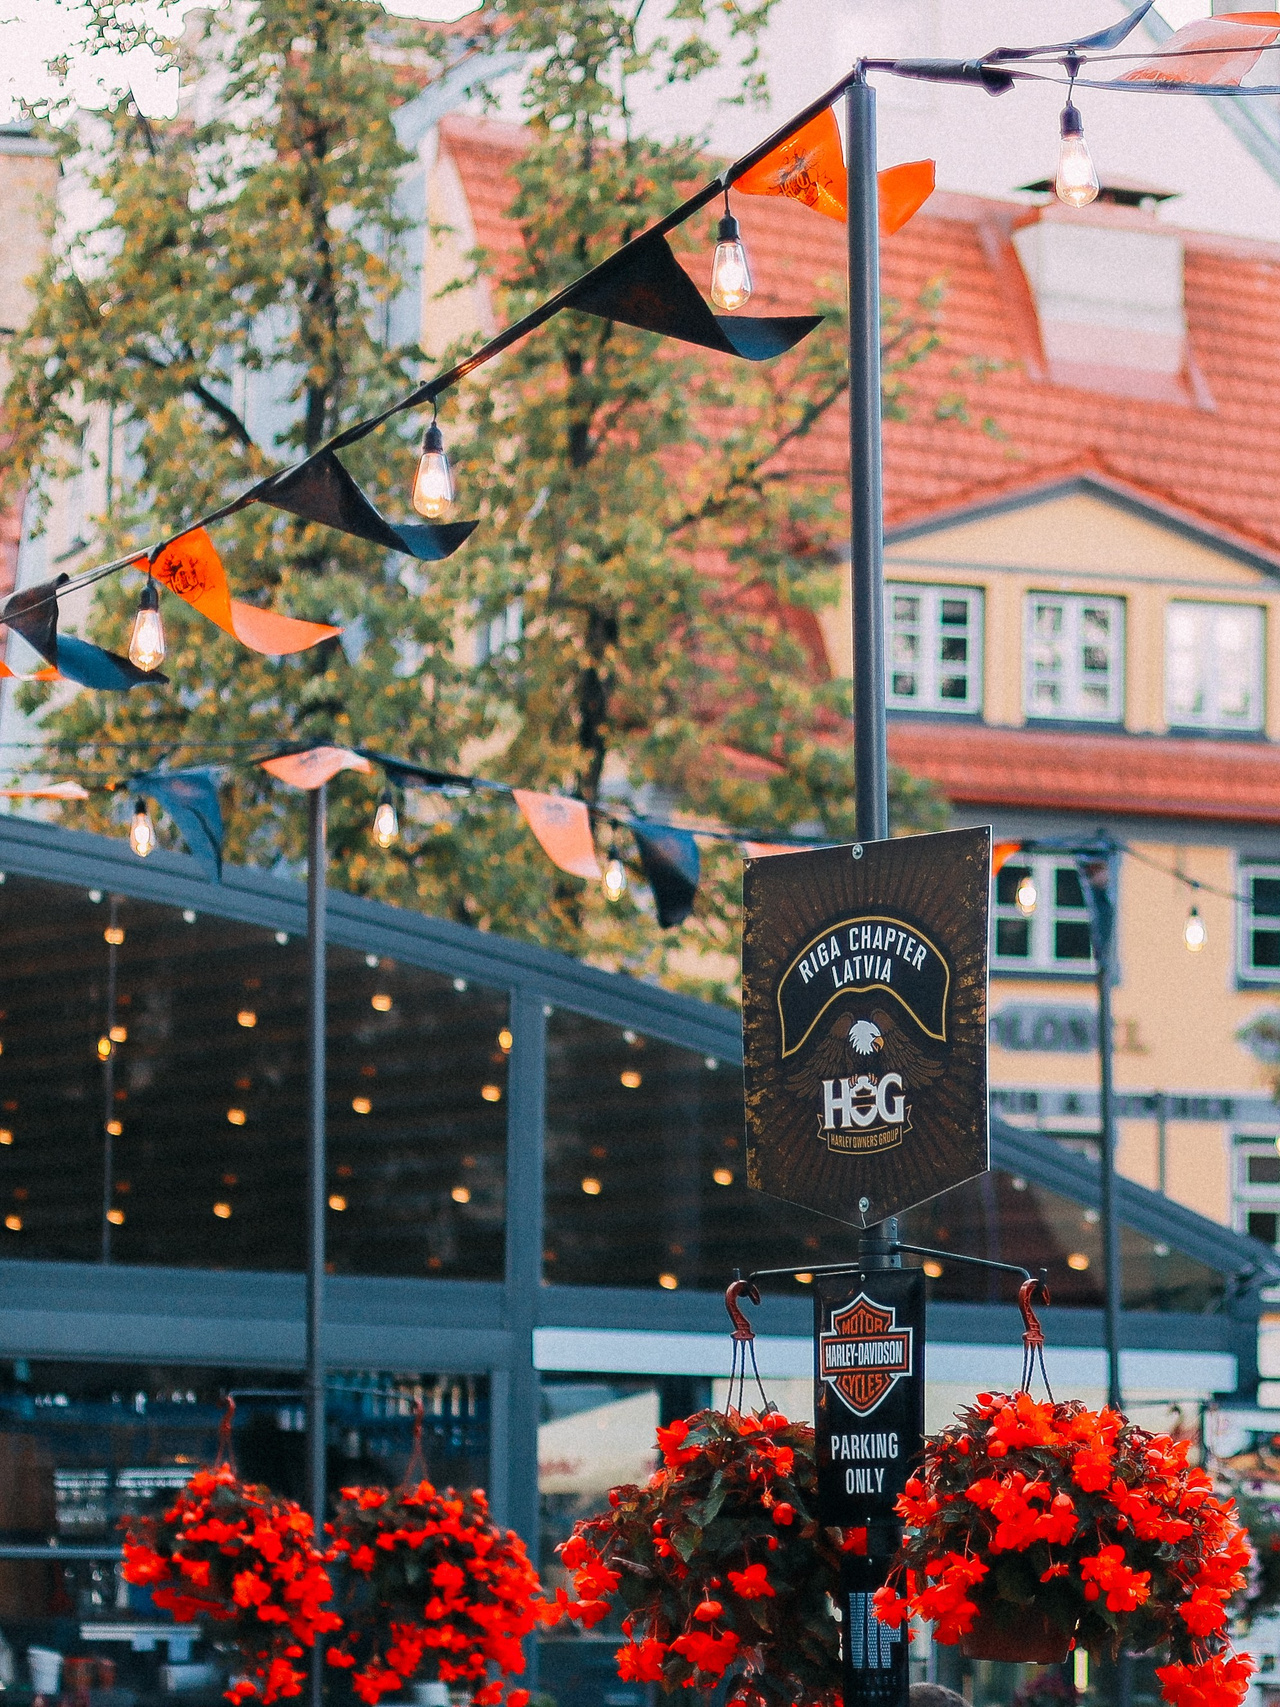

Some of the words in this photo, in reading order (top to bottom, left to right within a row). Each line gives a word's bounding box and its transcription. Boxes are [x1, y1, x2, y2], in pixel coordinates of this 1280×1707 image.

[797, 934, 842, 985] RIGA
[848, 924, 929, 972] CHAPTER
[832, 953, 892, 989] LATVIA
[821, 1073, 906, 1130] HOG
[830, 1133, 852, 1148] HARLEY
[852, 1134, 878, 1148] OWNERS
[878, 1128, 899, 1145] GROUP
[841, 1314, 884, 1335] MOTOR
[824, 1338, 904, 1369] HARLEY-DAVIDSON
[842, 1374, 884, 1401] CYCLES
[830, 1431, 899, 1461] PARKING
[844, 1467, 885, 1495] ONLY
